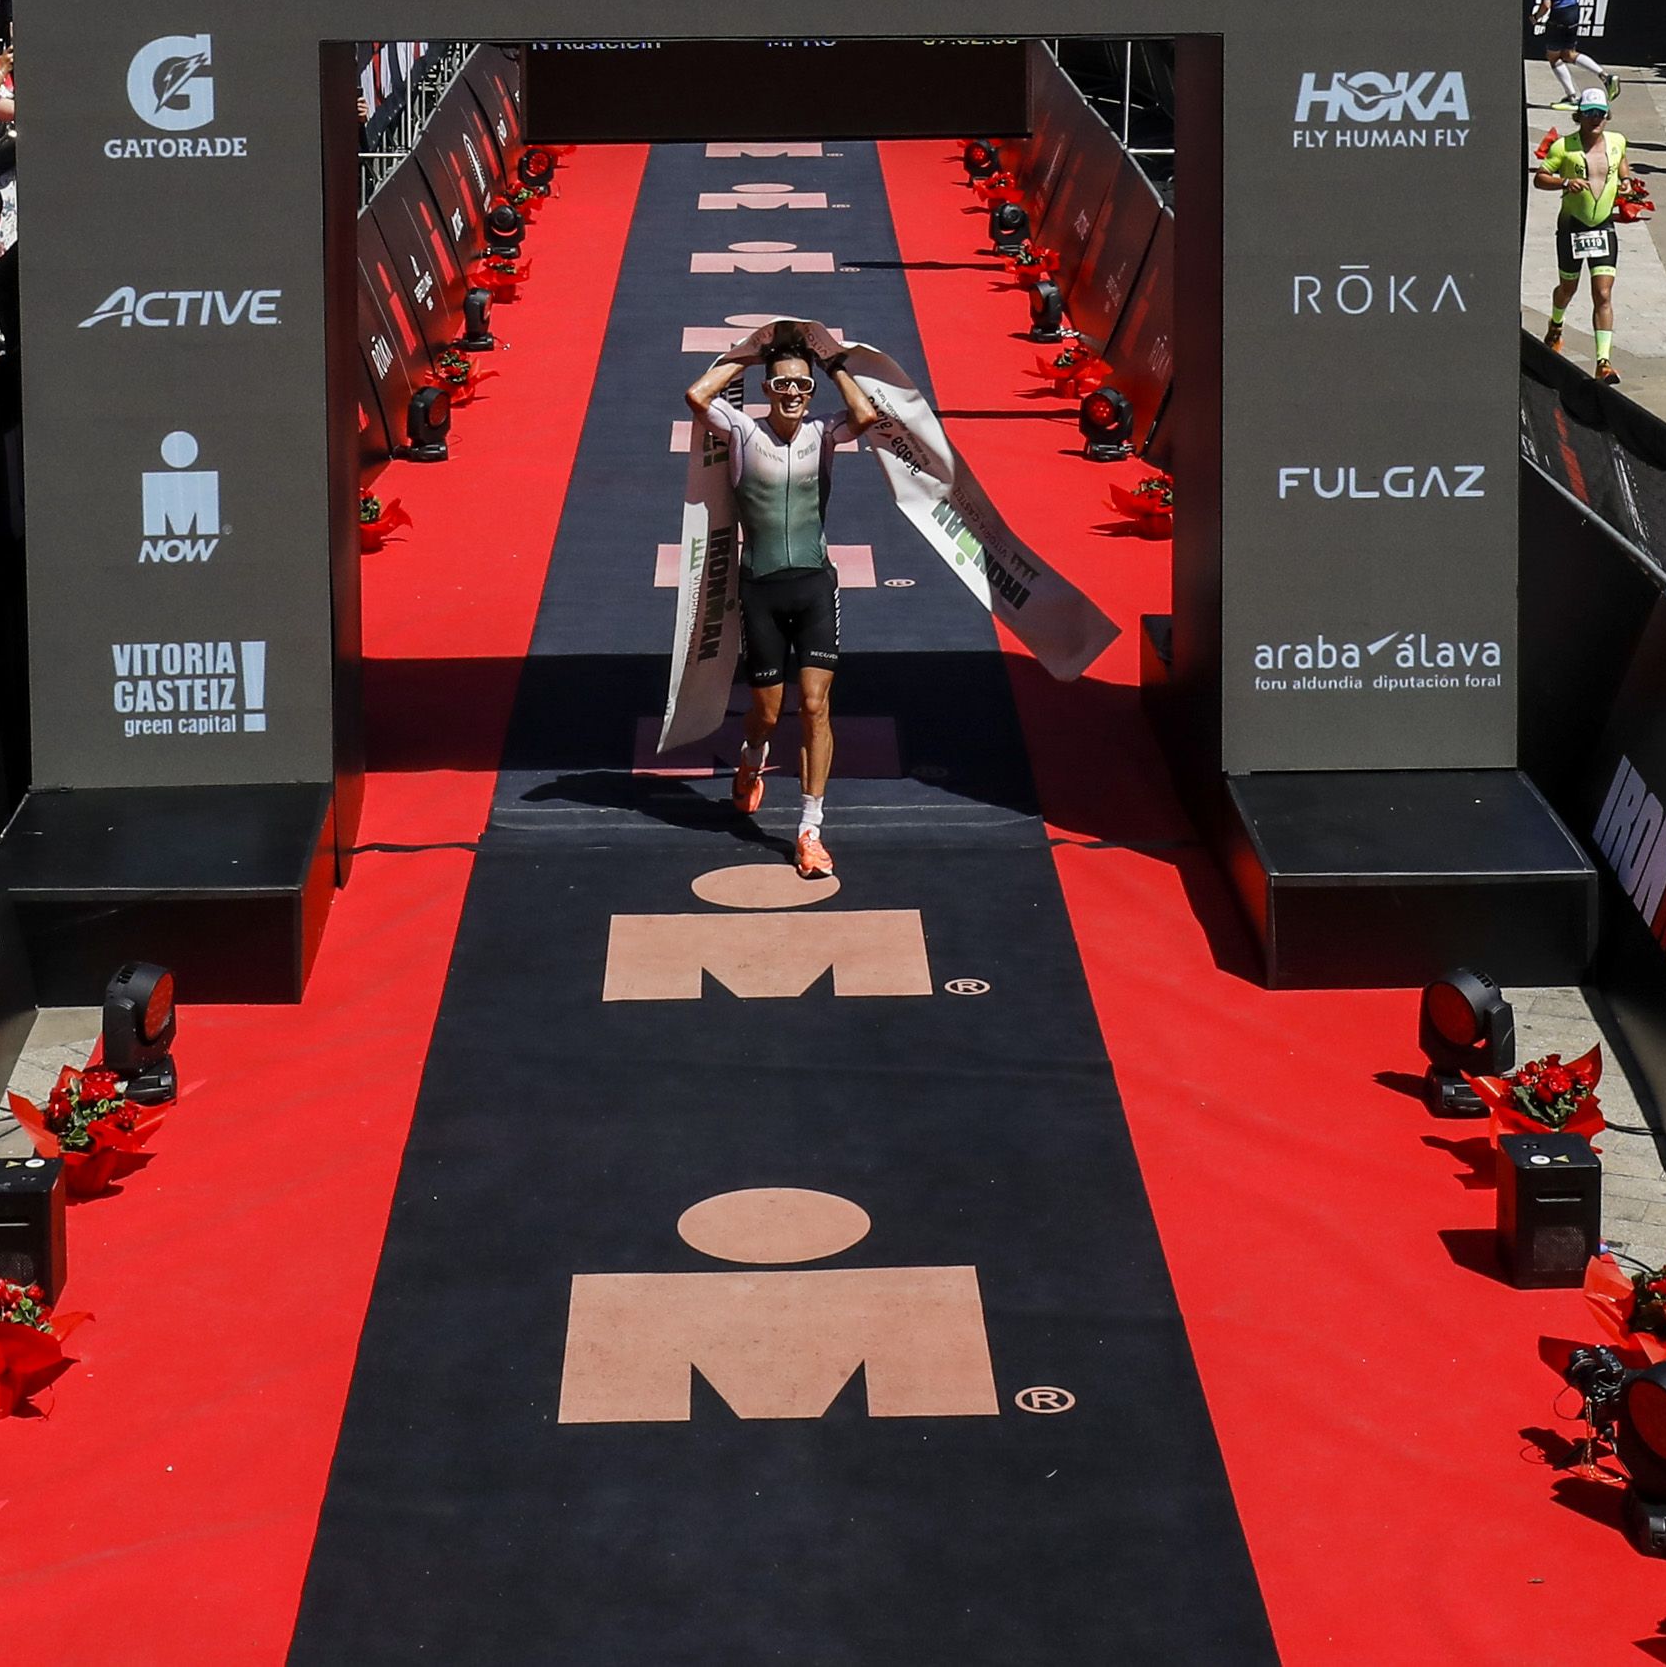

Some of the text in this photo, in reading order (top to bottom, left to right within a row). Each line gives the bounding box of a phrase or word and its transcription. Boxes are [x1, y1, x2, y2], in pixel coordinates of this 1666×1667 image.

[1294, 71, 1470, 123] HOKA
[103, 137, 248, 159] GATORADE
[1293, 128, 1470, 148] FLY HUMAN FLY
[78, 286, 282, 328] ACTIVE
[1279, 466, 1486, 499] FULGAZ
[138, 538, 220, 564] NOW
[931, 498, 1031, 611] IRONMAN
[697, 525, 734, 662] IRONMAN
[111, 642, 236, 677] VITORIA
[1254, 630, 1502, 670] araba álava
[114, 679, 236, 713] GASTEIZ
[1254, 673, 1503, 692] foru aldundia diputación foral
[124, 714, 237, 737] green capital
